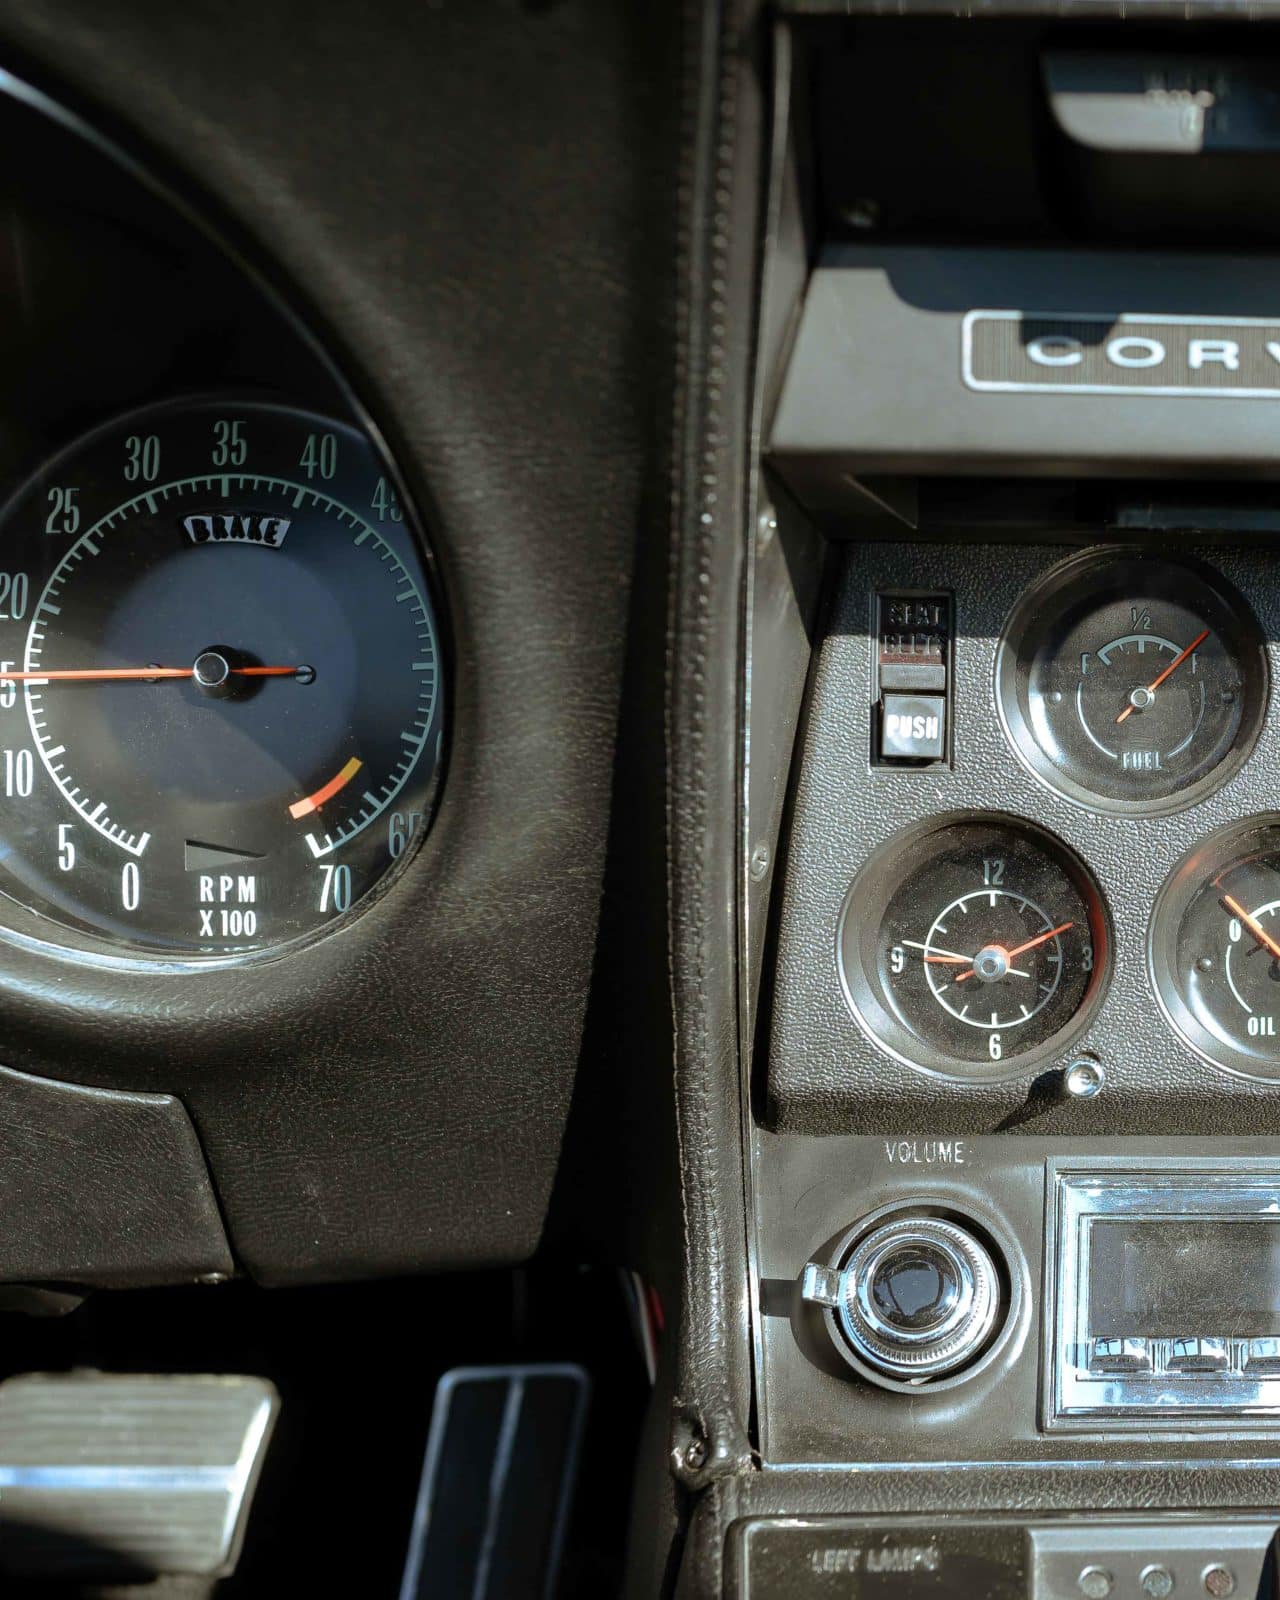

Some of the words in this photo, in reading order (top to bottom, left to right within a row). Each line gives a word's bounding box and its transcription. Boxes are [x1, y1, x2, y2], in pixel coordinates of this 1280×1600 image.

[212, 420, 247, 466] 35
[300, 434, 337, 479] 40
[124, 436, 160, 481] 30
[46, 487, 80, 534] 25
[193, 515, 280, 546] BRAKE
[0, 572, 28, 620] 20
[886, 713, 938, 740] PUSH
[4, 749, 34, 797] 10
[1122, 750, 1162, 772] FUEL
[58, 823, 76, 872] 5
[983, 859, 1004, 885] 12
[121, 863, 140, 911] 0
[200, 876, 256, 904] RPM
[318, 864, 351, 913] 70
[200, 910, 213, 937] X
[221, 910, 257, 937] 100
[1228, 918, 1241, 942] 0
[890, 946, 904, 974] 9
[1081, 947, 1093, 972] 3
[1247, 1016, 1277, 1036] OIL
[989, 1034, 1002, 1060] 6
[885, 1140, 965, 1165] VOLUME
[811, 1548, 858, 1572] LEFT
